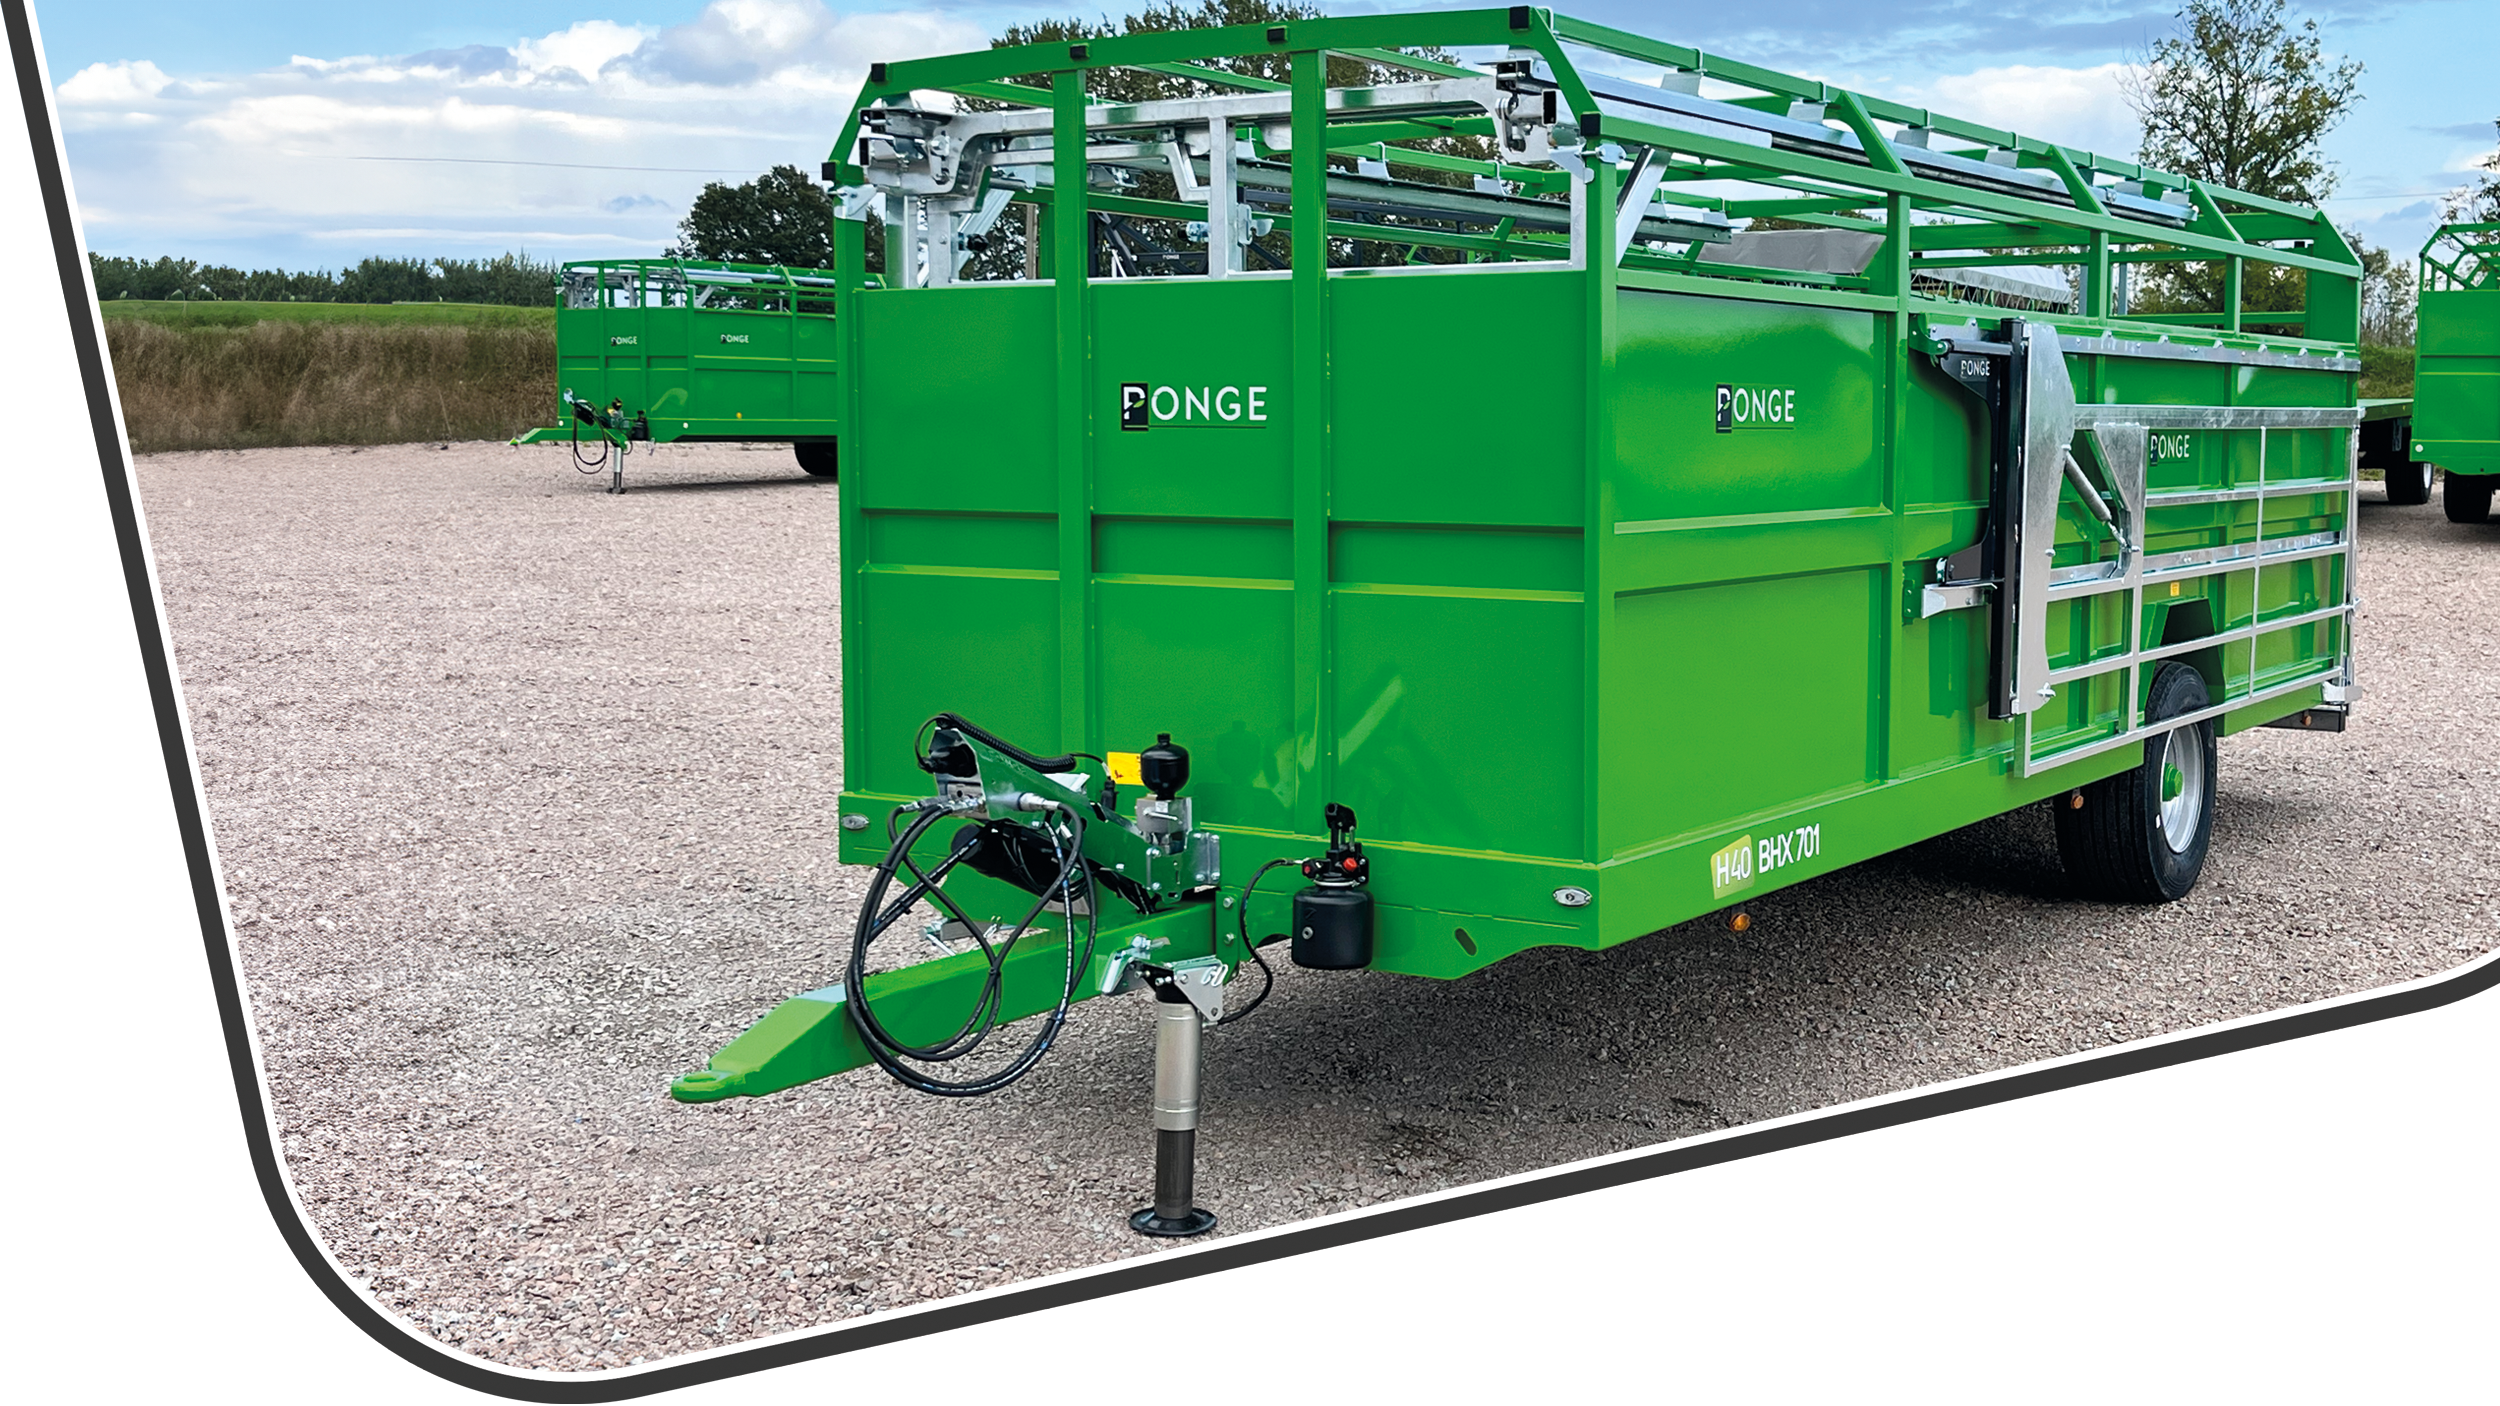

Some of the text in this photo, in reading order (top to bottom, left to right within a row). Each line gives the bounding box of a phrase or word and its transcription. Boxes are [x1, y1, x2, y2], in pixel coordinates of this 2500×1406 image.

[1961, 360, 1990, 376] PONGE
[1123, 386, 1267, 421] PONGE
[1717, 388, 1795, 422] PONGE
[2150, 434, 2190, 459] PONGE
[1716, 846, 1752, 888] H40
